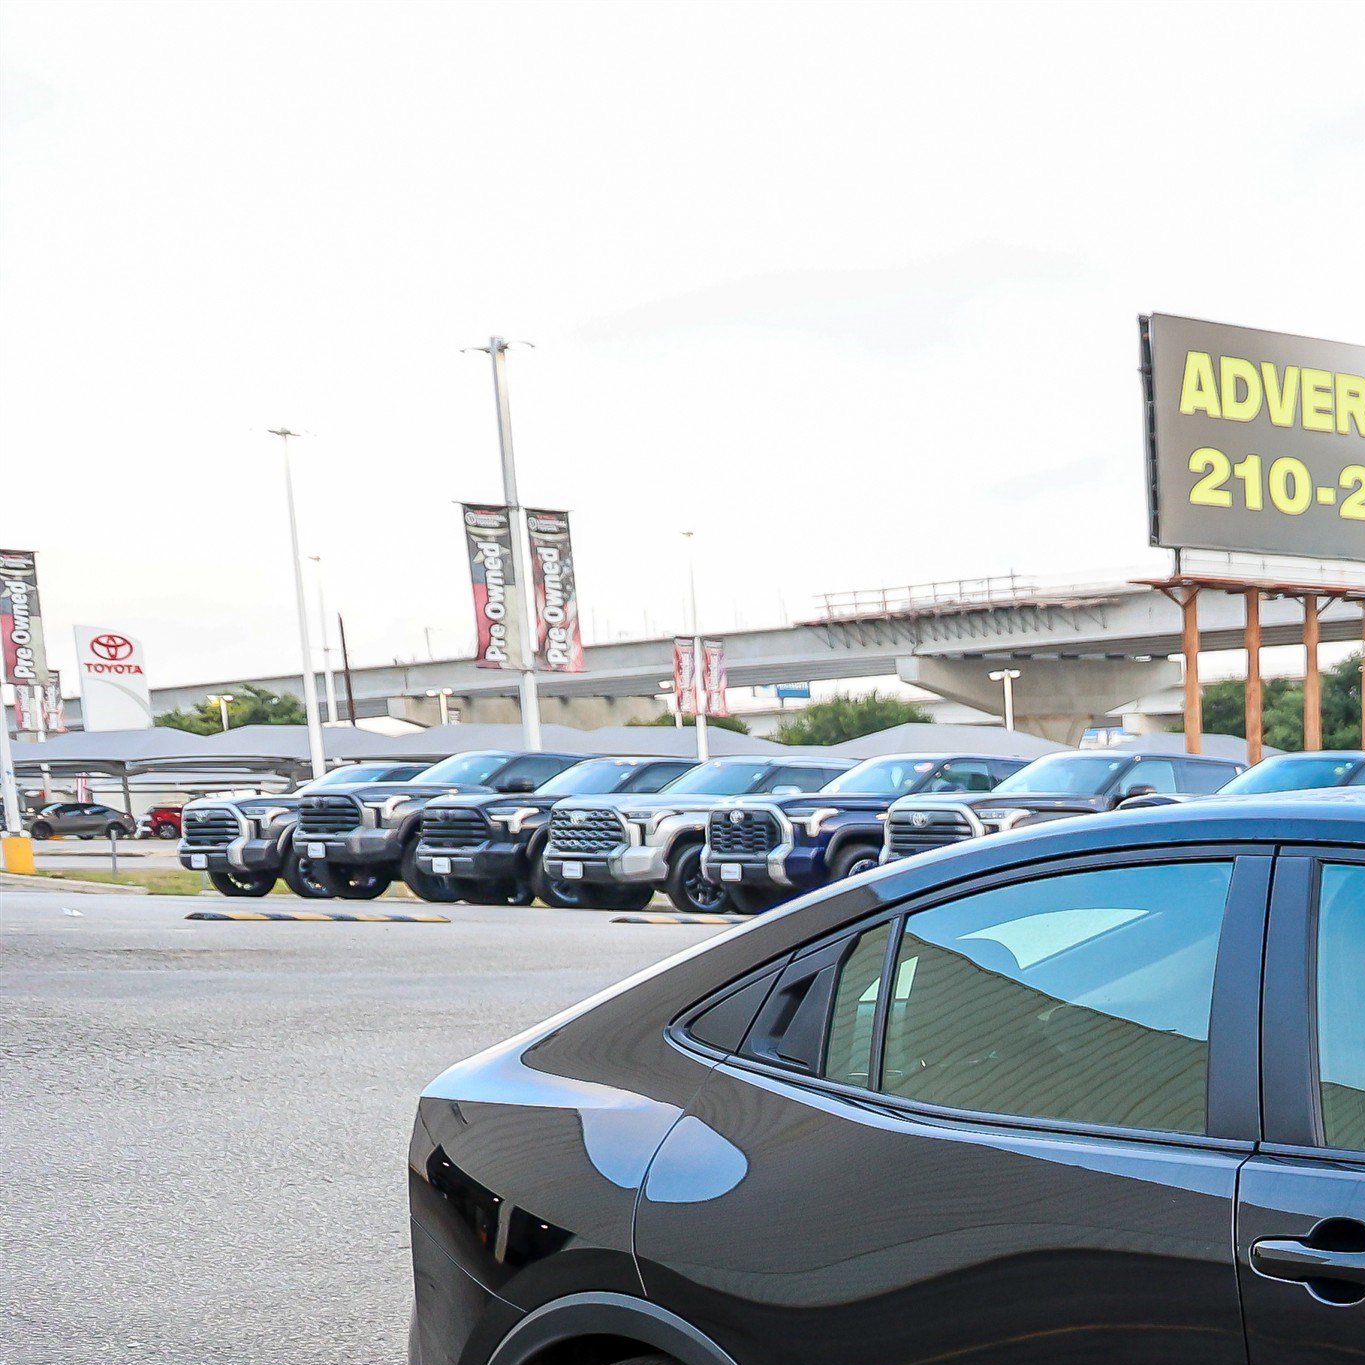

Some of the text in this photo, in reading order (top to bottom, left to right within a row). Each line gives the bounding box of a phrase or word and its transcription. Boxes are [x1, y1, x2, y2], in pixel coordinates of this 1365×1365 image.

[476, 541, 506, 621] Owned
[536, 546, 566, 624] Owned
[4, 580, 32, 644] Owned
[484, 623, 507, 661] Pre
[546, 626, 570, 665] Pre
[13, 645, 37, 680] Pre
[83, 662, 144, 675] TOYOTA
